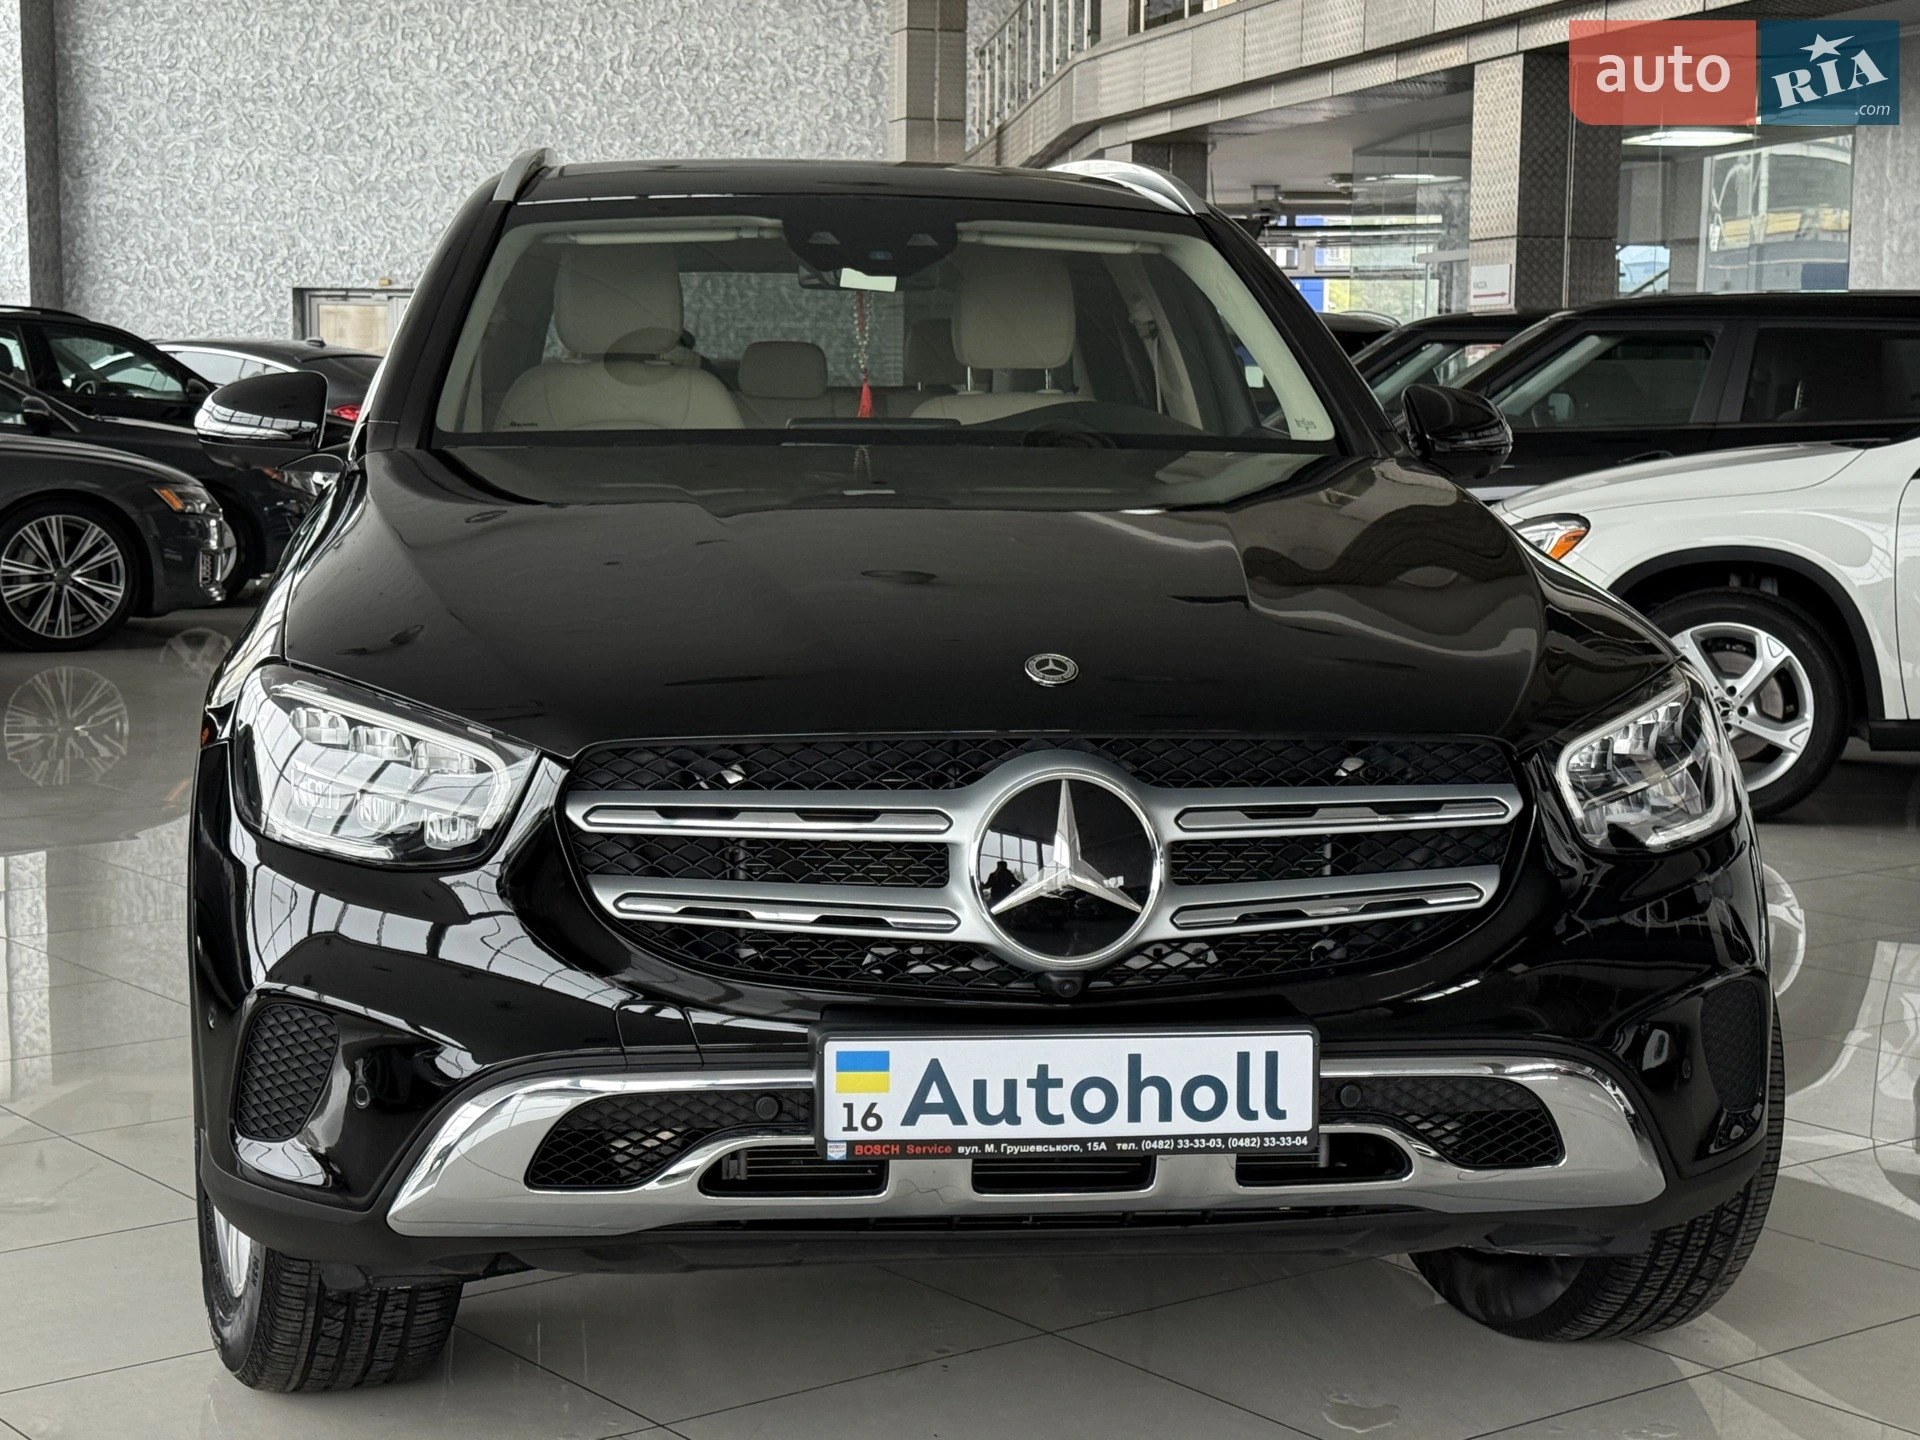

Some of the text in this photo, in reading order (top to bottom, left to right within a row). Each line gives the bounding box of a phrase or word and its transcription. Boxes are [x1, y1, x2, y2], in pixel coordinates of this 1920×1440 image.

[899, 1050, 1288, 1127] Autoholl
[841, 1102, 884, 1132] 16
[854, 1143, 953, 1156] BOSCH Service
[957, 1135, 1308, 1155] вул. М. Грушевського, 15А тел. (0482) 33-33-03, (0482) 33-33-04
